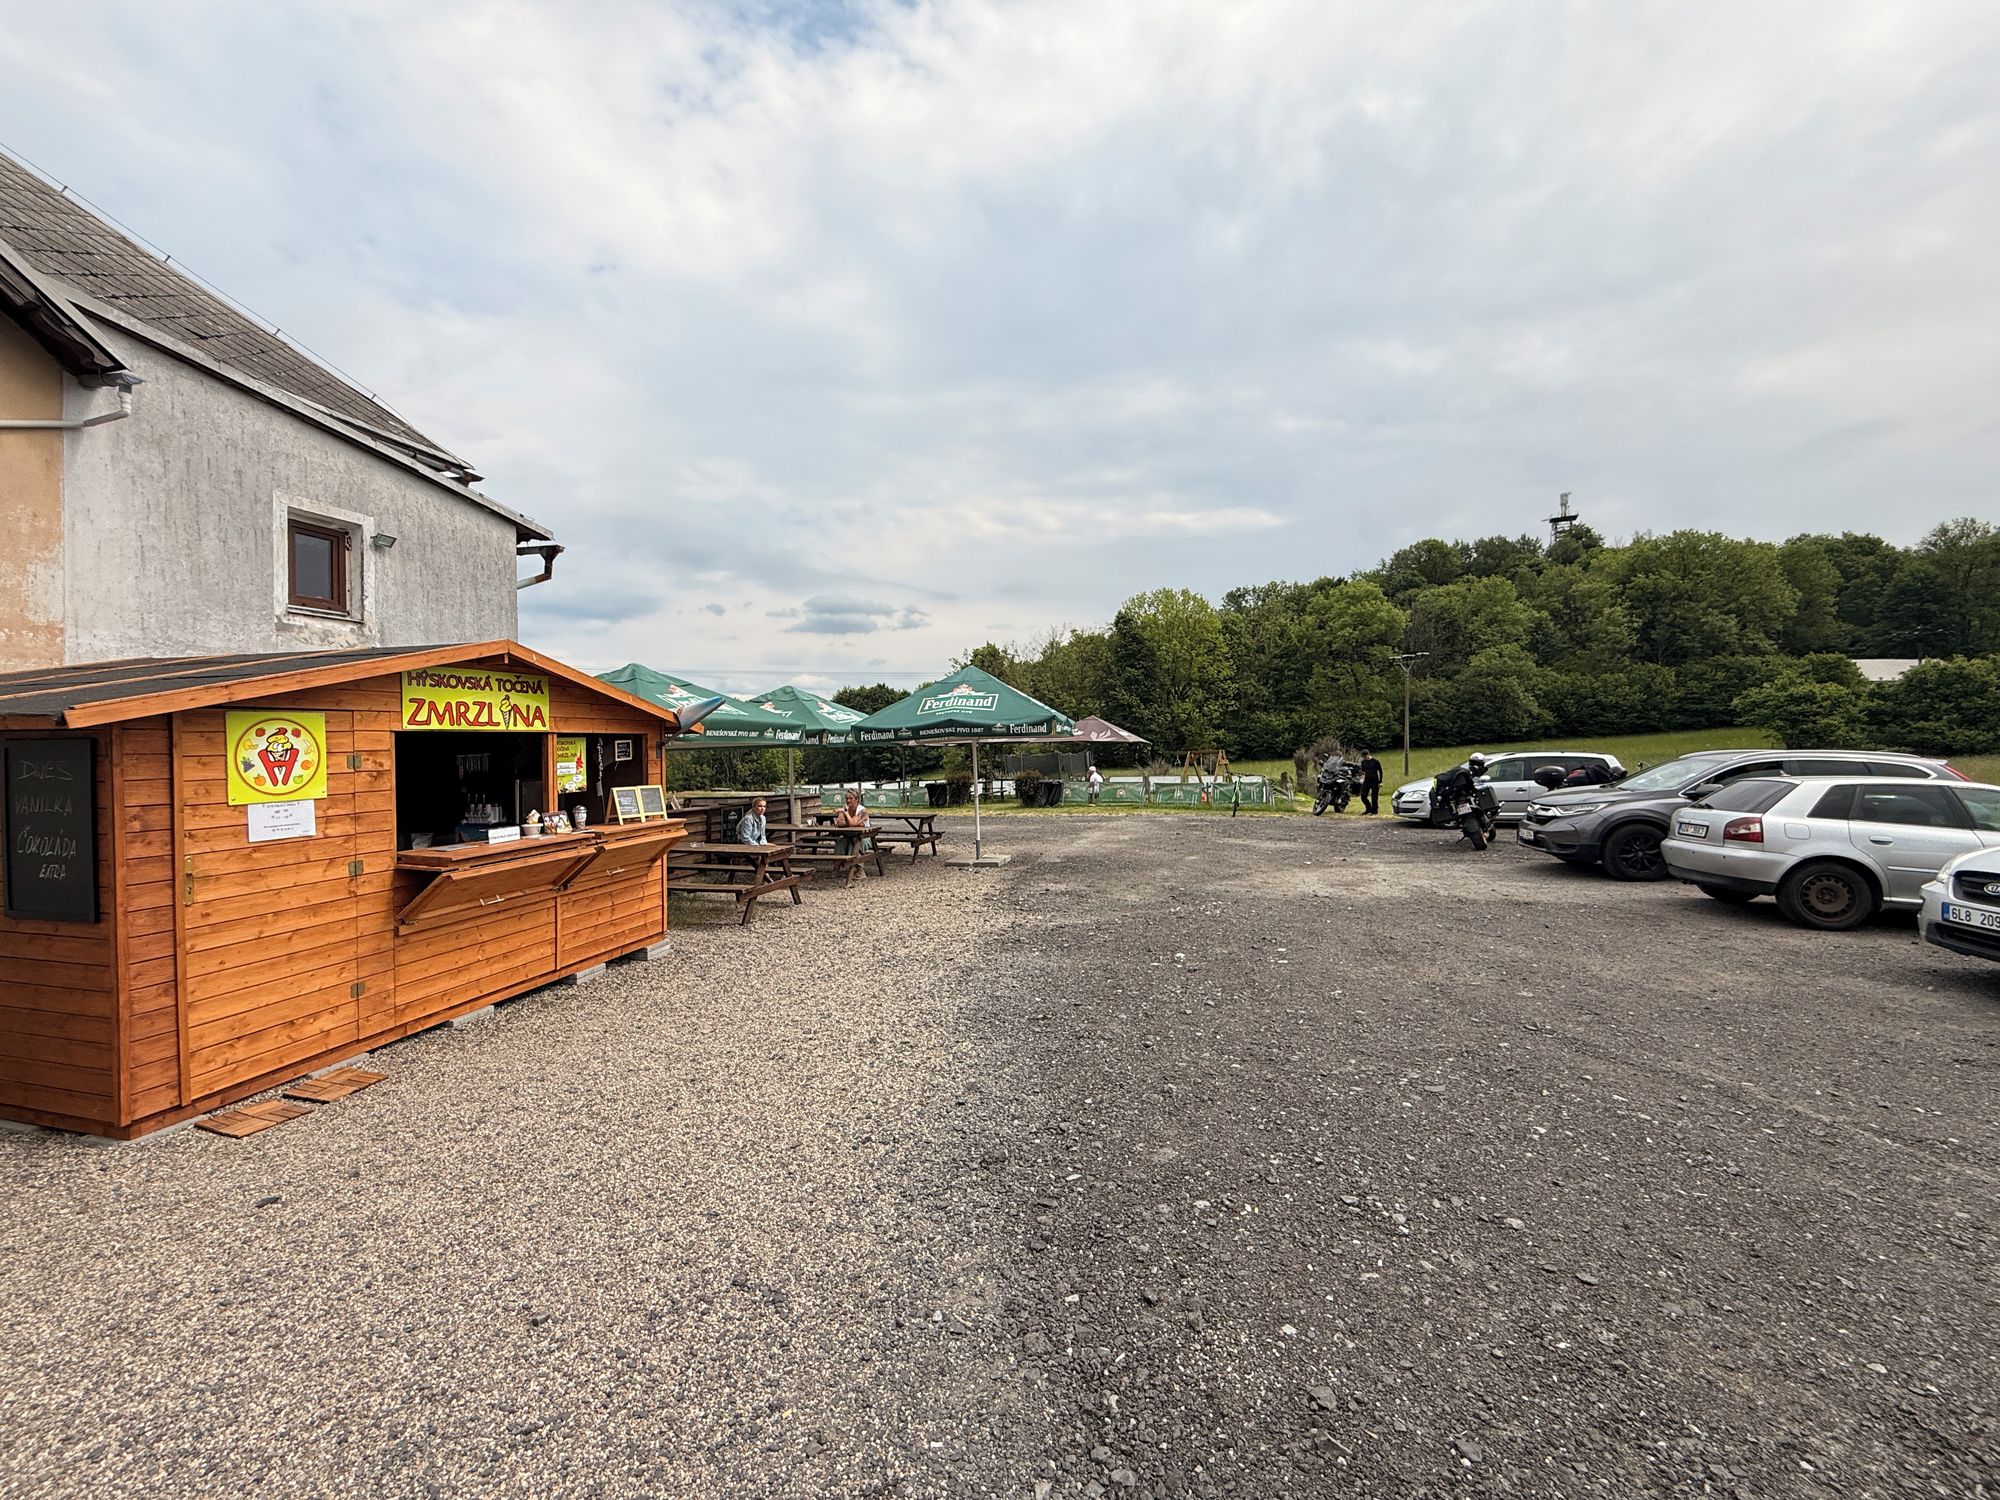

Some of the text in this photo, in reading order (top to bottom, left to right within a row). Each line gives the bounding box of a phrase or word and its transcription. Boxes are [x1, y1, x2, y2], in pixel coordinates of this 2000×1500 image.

[407, 669, 544, 694] HÝSKOVSKÁ TOČENÁ
[924, 696, 993, 710] Ferdinand
[775, 729, 801, 740] Ferdinand
[860, 729, 895, 741] Ferdinand
[919, 726, 956, 736] BENEŠOVSKÉ
[1009, 722, 1047, 734] Ferdinand
[827, 734, 846, 743] Ferdinand
[16, 760, 73, 781] DNES
[15, 794, 73, 816] VANILKA
[17, 825, 76, 859] ČOKOLÁDA
[1951, 907, 1972, 922] 6L8
